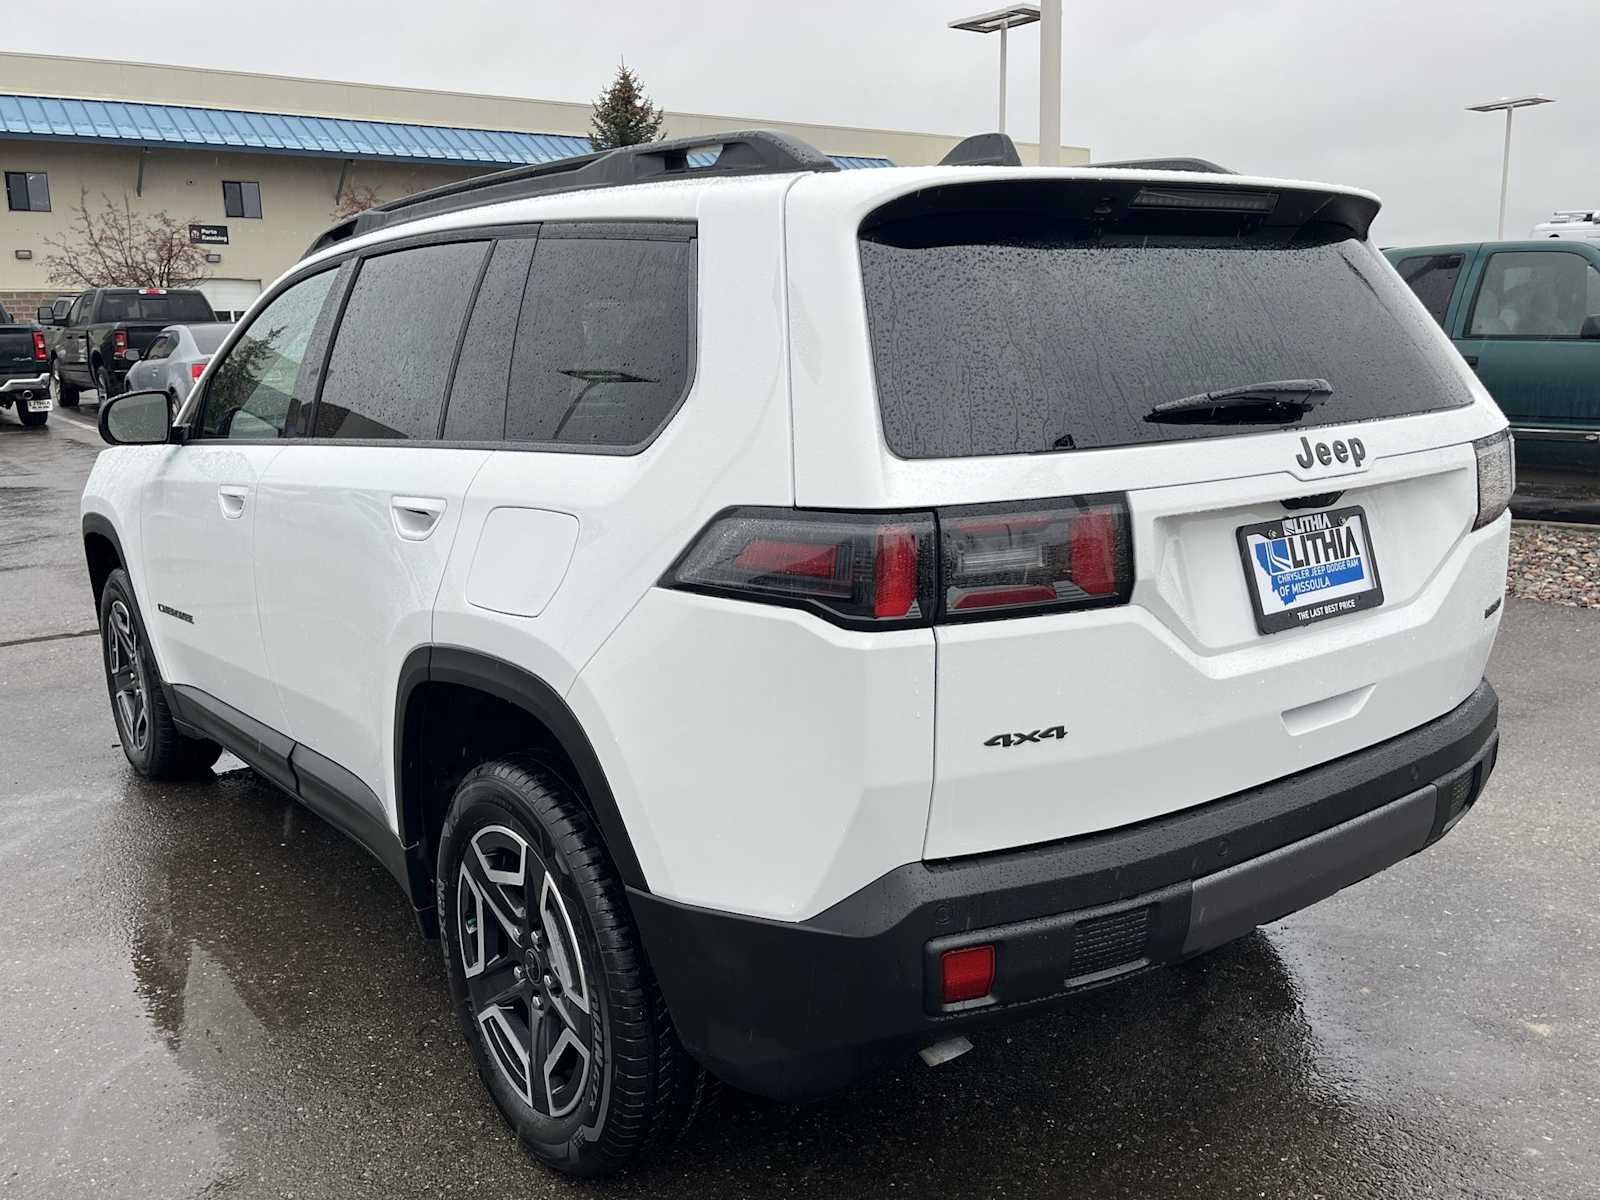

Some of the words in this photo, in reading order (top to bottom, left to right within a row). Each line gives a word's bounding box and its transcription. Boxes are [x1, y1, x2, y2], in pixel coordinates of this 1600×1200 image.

[1296, 437, 1365, 469] Jeep
[1294, 513, 1331, 534] LITHIA
[1288, 526, 1360, 568] LITHIA
[1277, 569, 1310, 584] CHRYSLER
[1311, 565, 1326, 577] JEEP
[1327, 561, 1347, 573] DODGE
[1347, 558, 1360, 569] RAM
[1280, 585, 1290, 597] OF
[1291, 576, 1331, 593] MISSOULA
[1297, 610, 1310, 621] THE
[1309, 606, 1325, 618] LAST
[1324, 603, 1339, 615] BEST
[1339, 599, 1356, 611] PRICE
